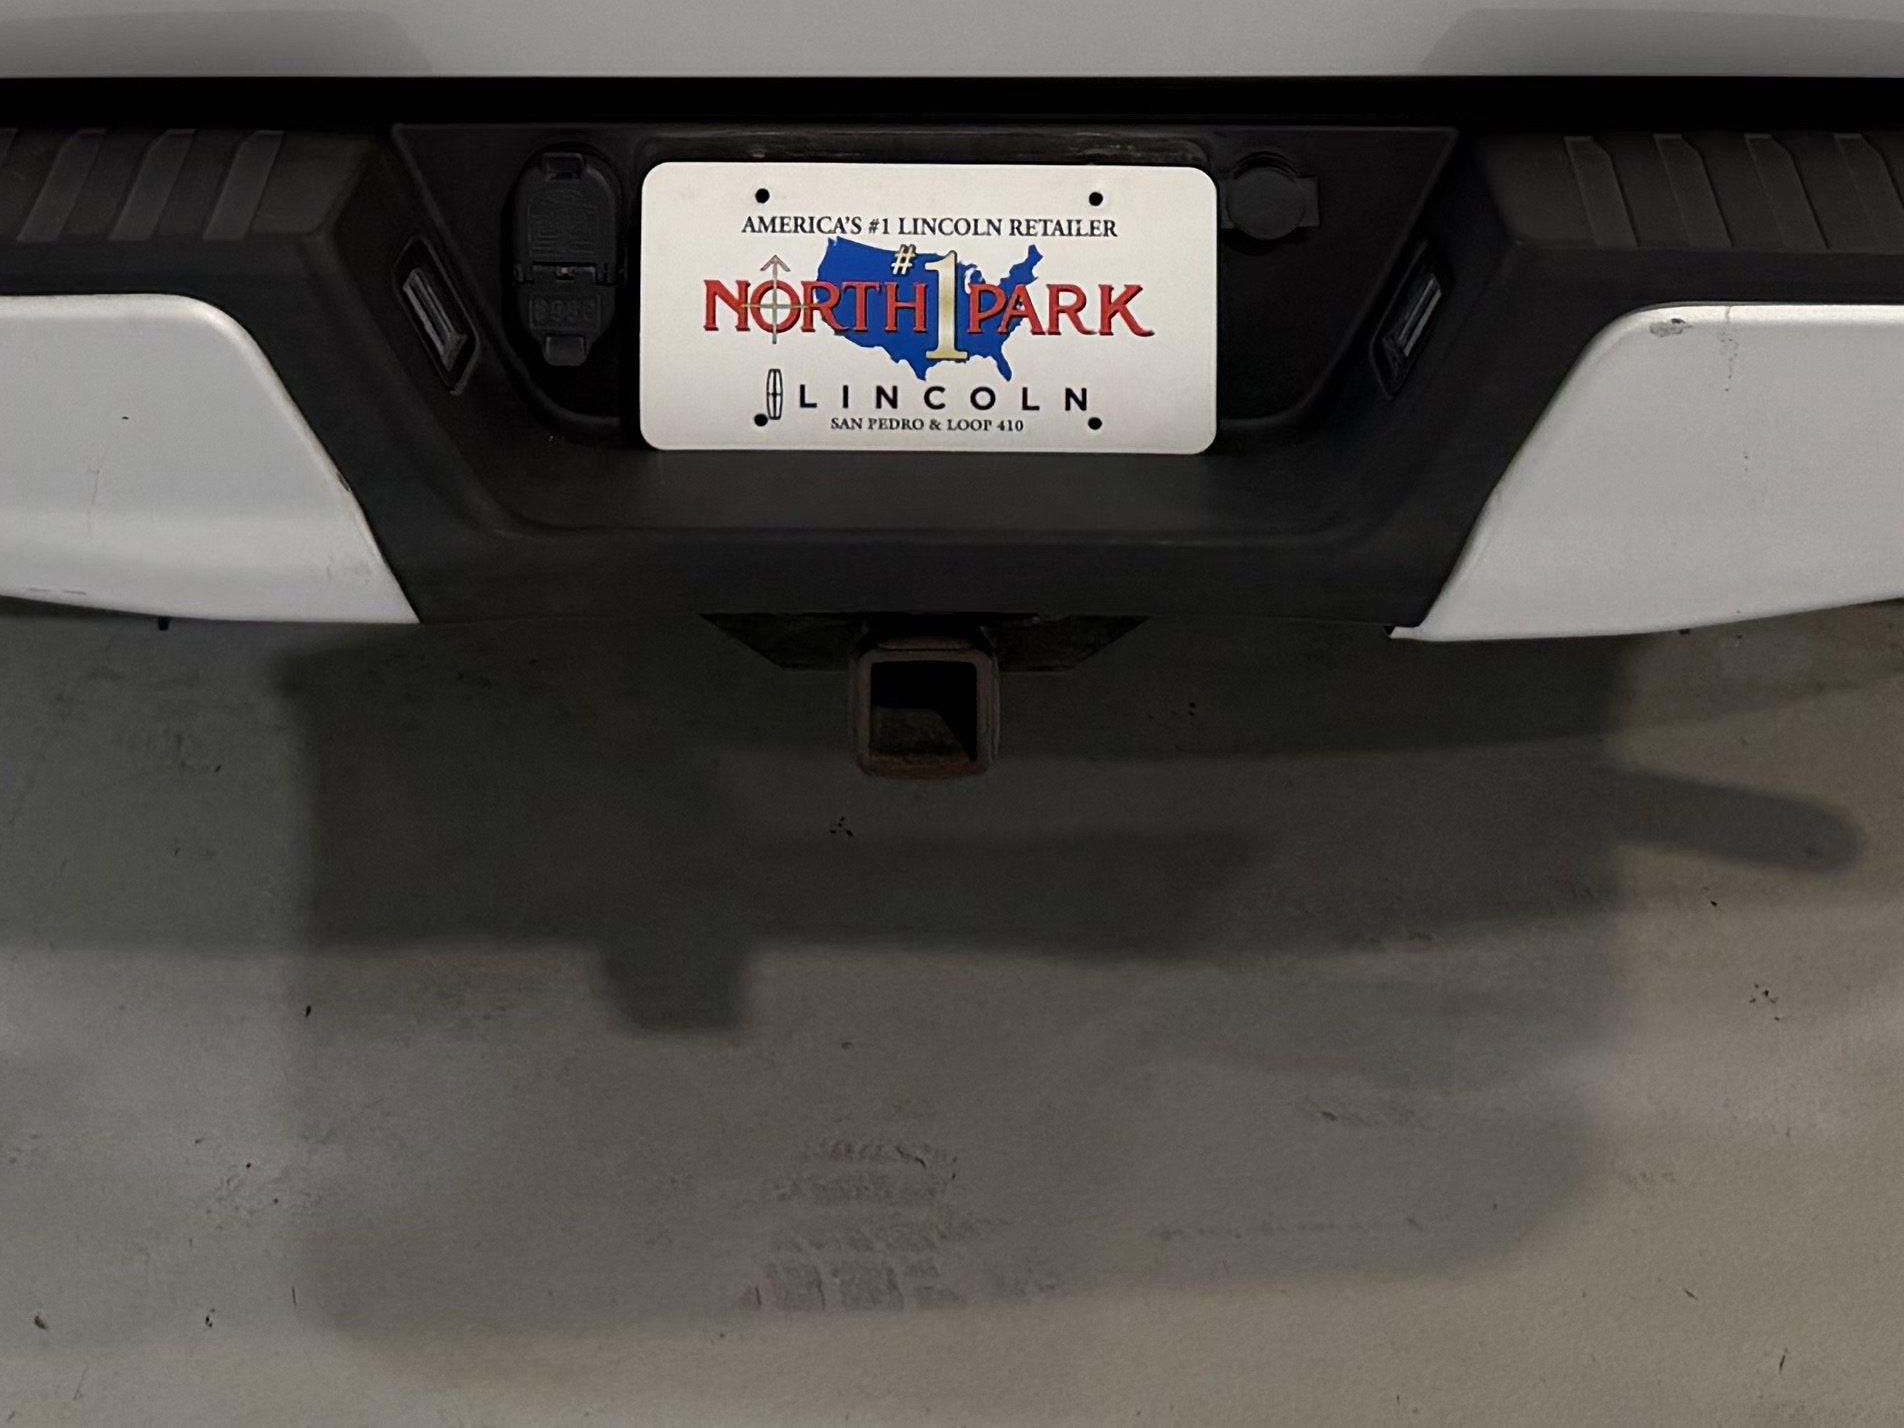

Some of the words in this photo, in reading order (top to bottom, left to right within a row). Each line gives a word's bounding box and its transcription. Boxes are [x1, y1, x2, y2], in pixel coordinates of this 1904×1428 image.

[742, 216, 862, 235] AMERICA'S
[868, 217, 890, 236] #1
[898, 218, 1003, 237] LINCOLN
[1008, 219, 1118, 238] RETAILER
[703, 279, 927, 333] NORTH
[969, 283, 1156, 336] PARK
[799, 384, 1088, 412] LINCOLN
[831, 418, 863, 431] SAN
[868, 418, 925, 431] PEDRO
[930, 418, 942, 431] &
[946, 419, 993, 432] LOOP
[997, 419, 1025, 432] 410
